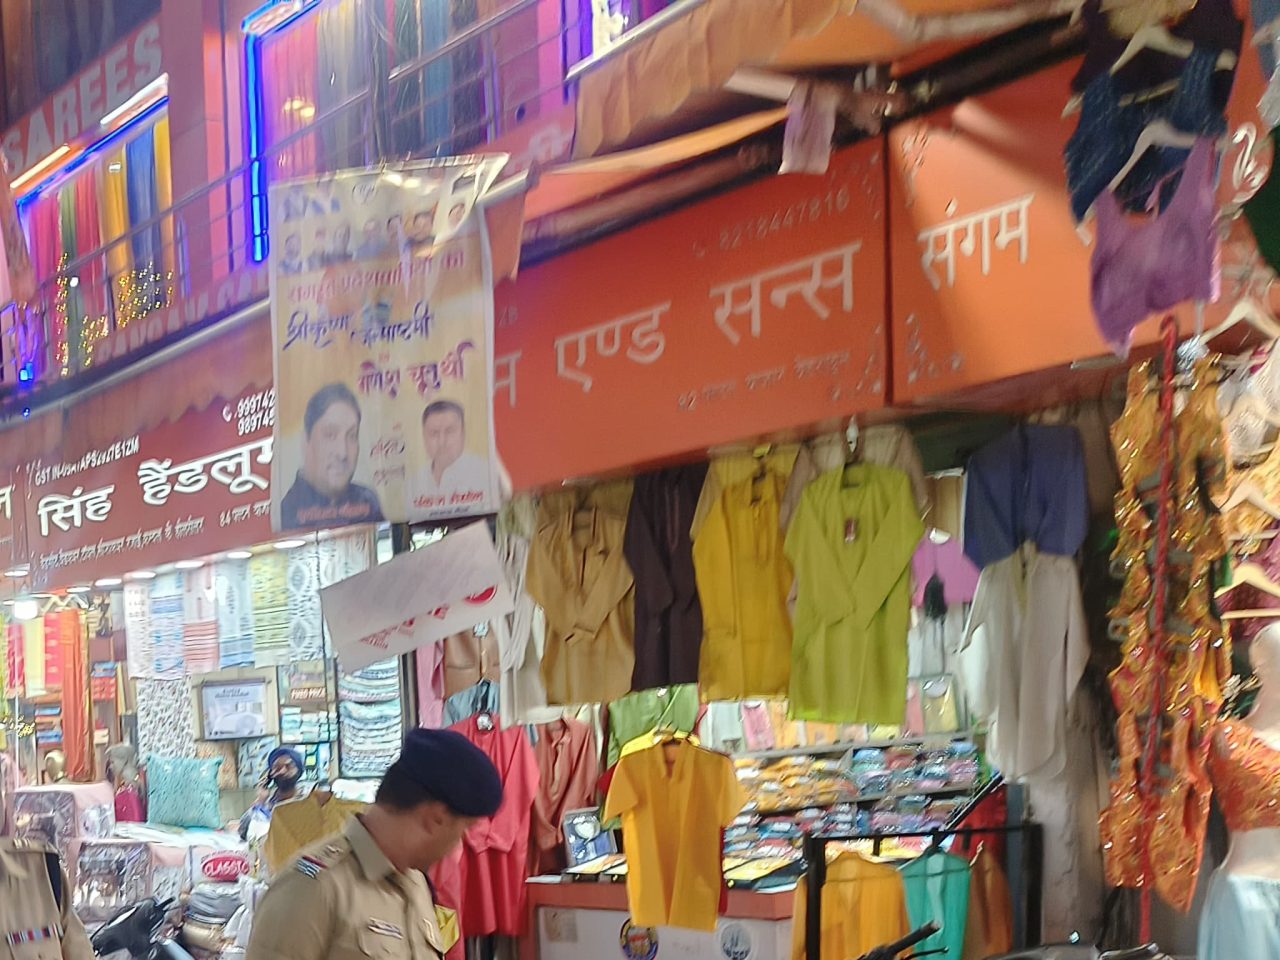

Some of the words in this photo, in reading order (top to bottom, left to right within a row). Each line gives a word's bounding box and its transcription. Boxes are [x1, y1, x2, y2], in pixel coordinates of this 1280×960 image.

[1, 22, 163, 177] SAREES
[919, 193, 1035, 291] संगम
[553, 302, 671, 394] एण्ड
[708, 239, 862, 346] सन्स
[37, 484, 116, 537] सिंह
